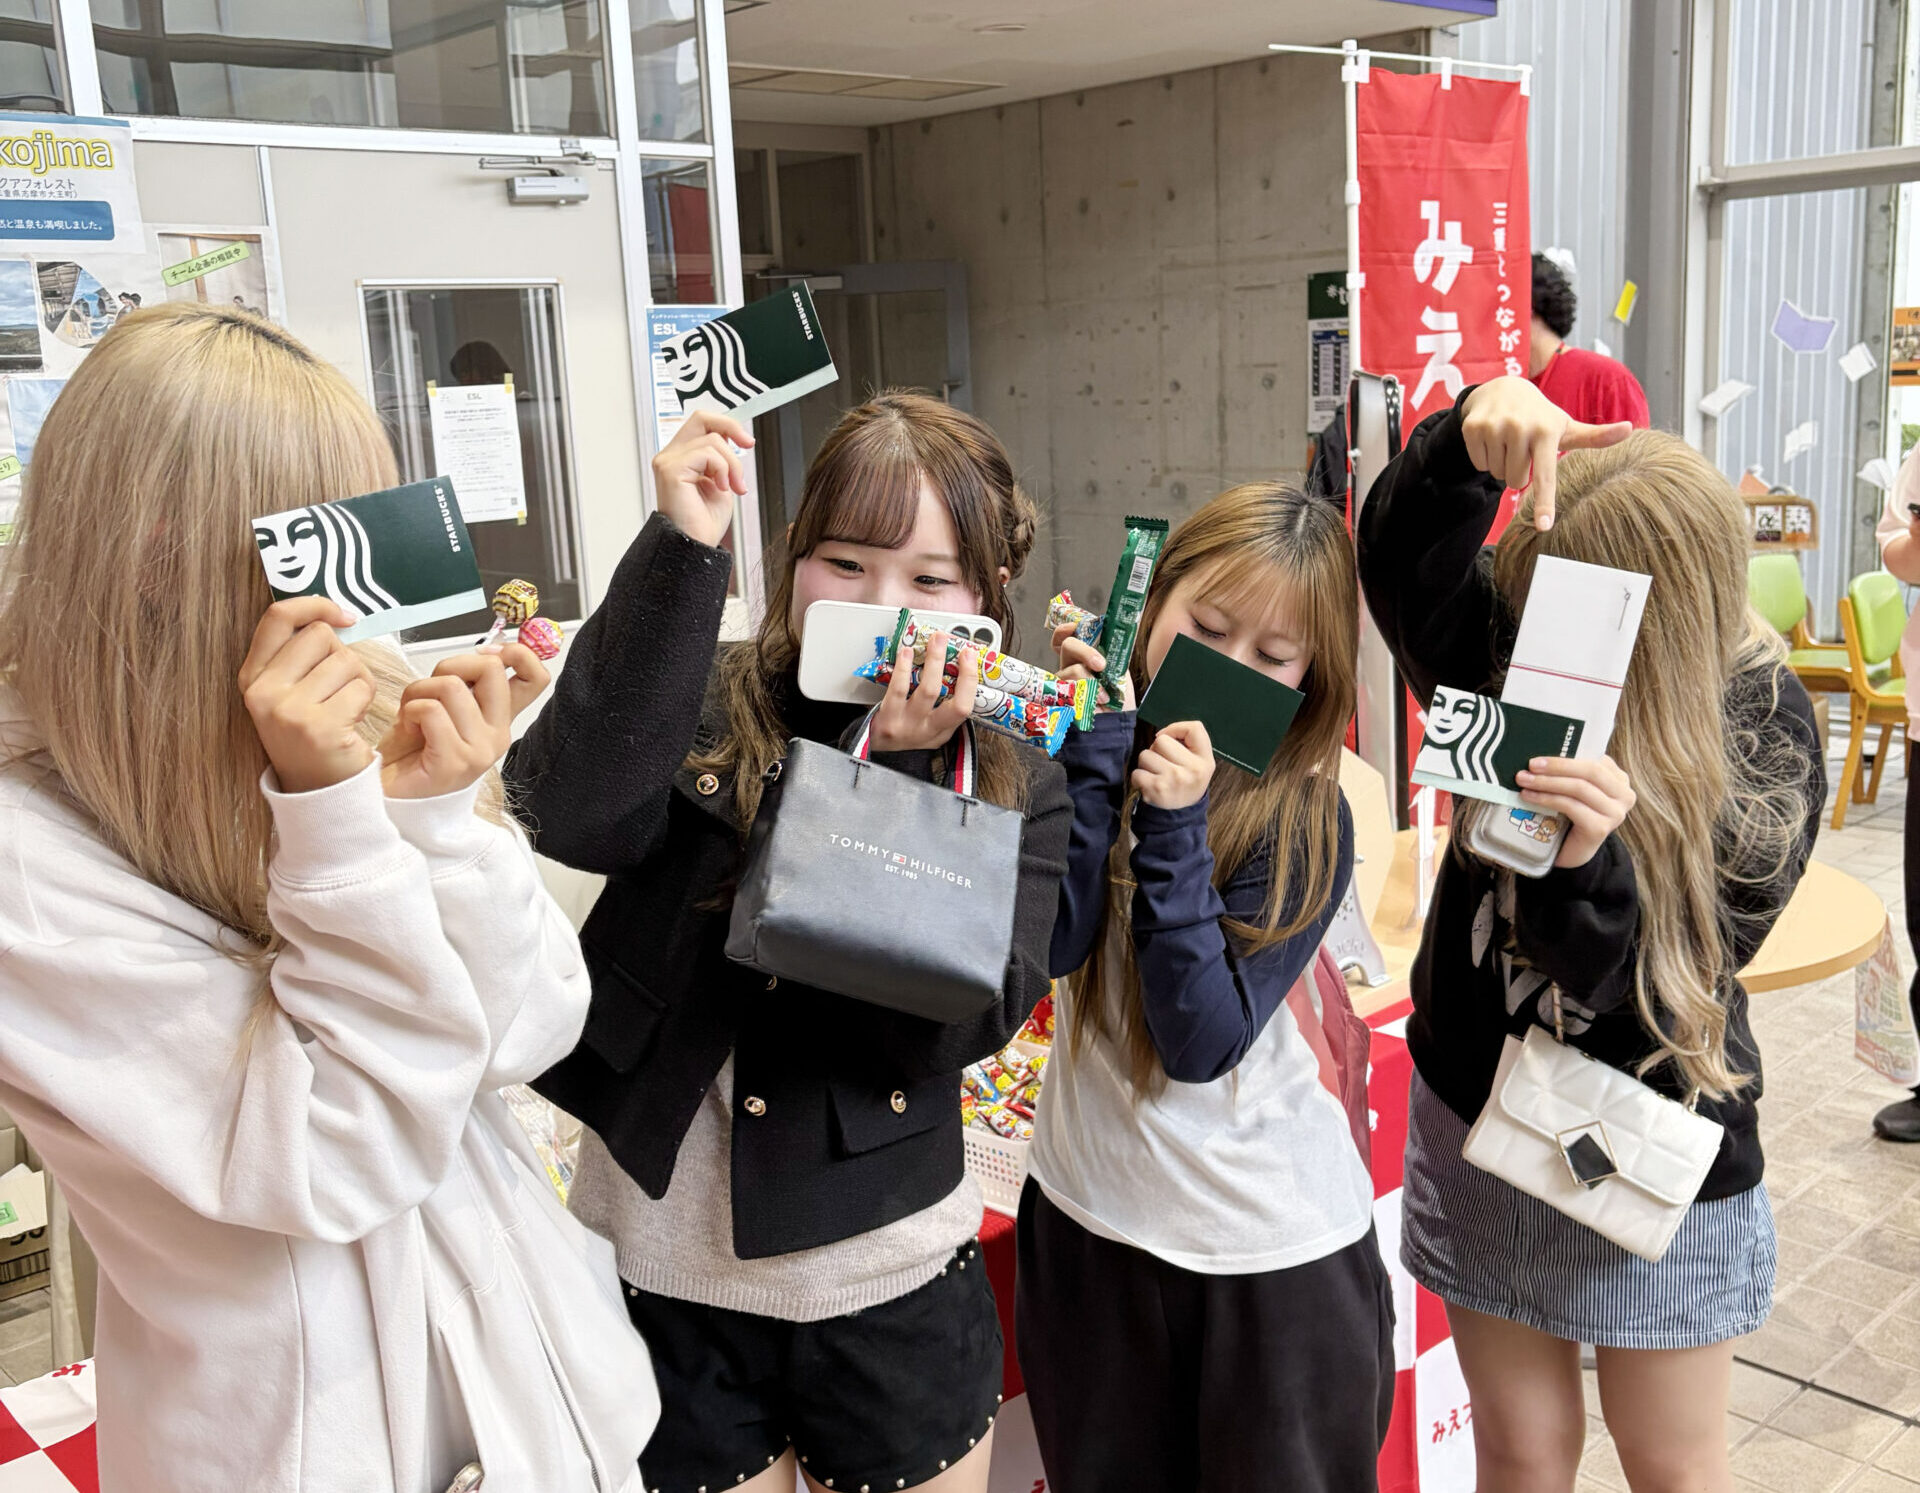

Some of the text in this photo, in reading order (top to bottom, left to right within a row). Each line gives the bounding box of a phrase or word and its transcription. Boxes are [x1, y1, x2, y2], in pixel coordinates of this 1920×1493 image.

[653, 323, 680, 335] ESL
[792, 291, 814, 340] STARBUCKS
[434, 487, 461, 552] STARBUCKS
[1559, 723, 1575, 758] RBUCKS
[830, 834, 972, 889] TOMMY HILFIGER
[885, 864, 918, 880] EST. 1985
